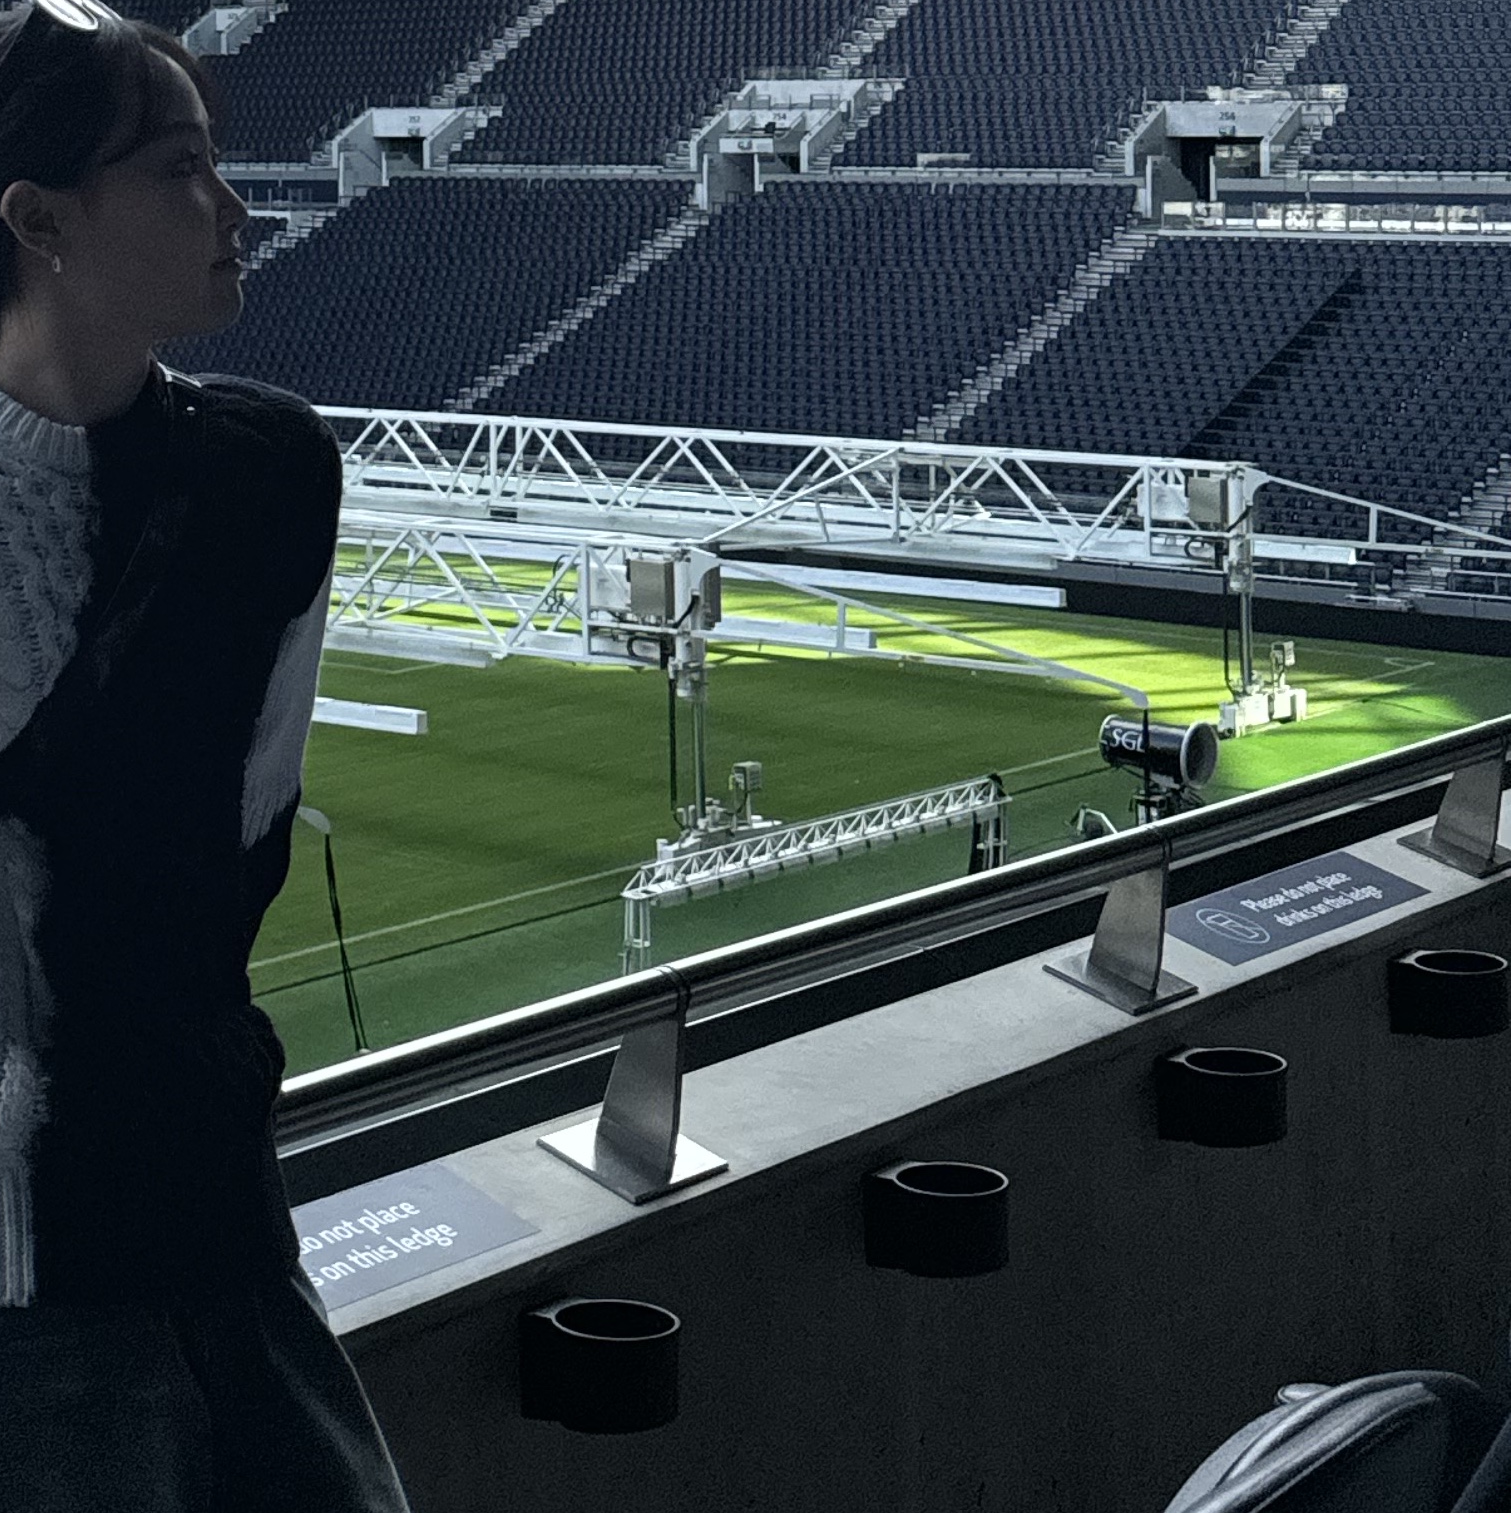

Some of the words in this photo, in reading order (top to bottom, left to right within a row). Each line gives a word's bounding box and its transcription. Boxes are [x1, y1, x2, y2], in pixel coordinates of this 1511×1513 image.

[1240, 893, 1290, 912] Please
[1279, 887, 1304, 900] do
[1297, 881, 1323, 894] not
[1315, 872, 1351, 890] place
[1274, 908, 1318, 926] drinks
[1311, 903, 1333, 914] on
[1322, 895, 1353, 909] this
[318, 1220, 365, 1245] not
[358, 1202, 420, 1235] place
[320, 1260, 356, 1281] on
[346, 1245, 398, 1270] this
[386, 1223, 458, 1253] ledge
